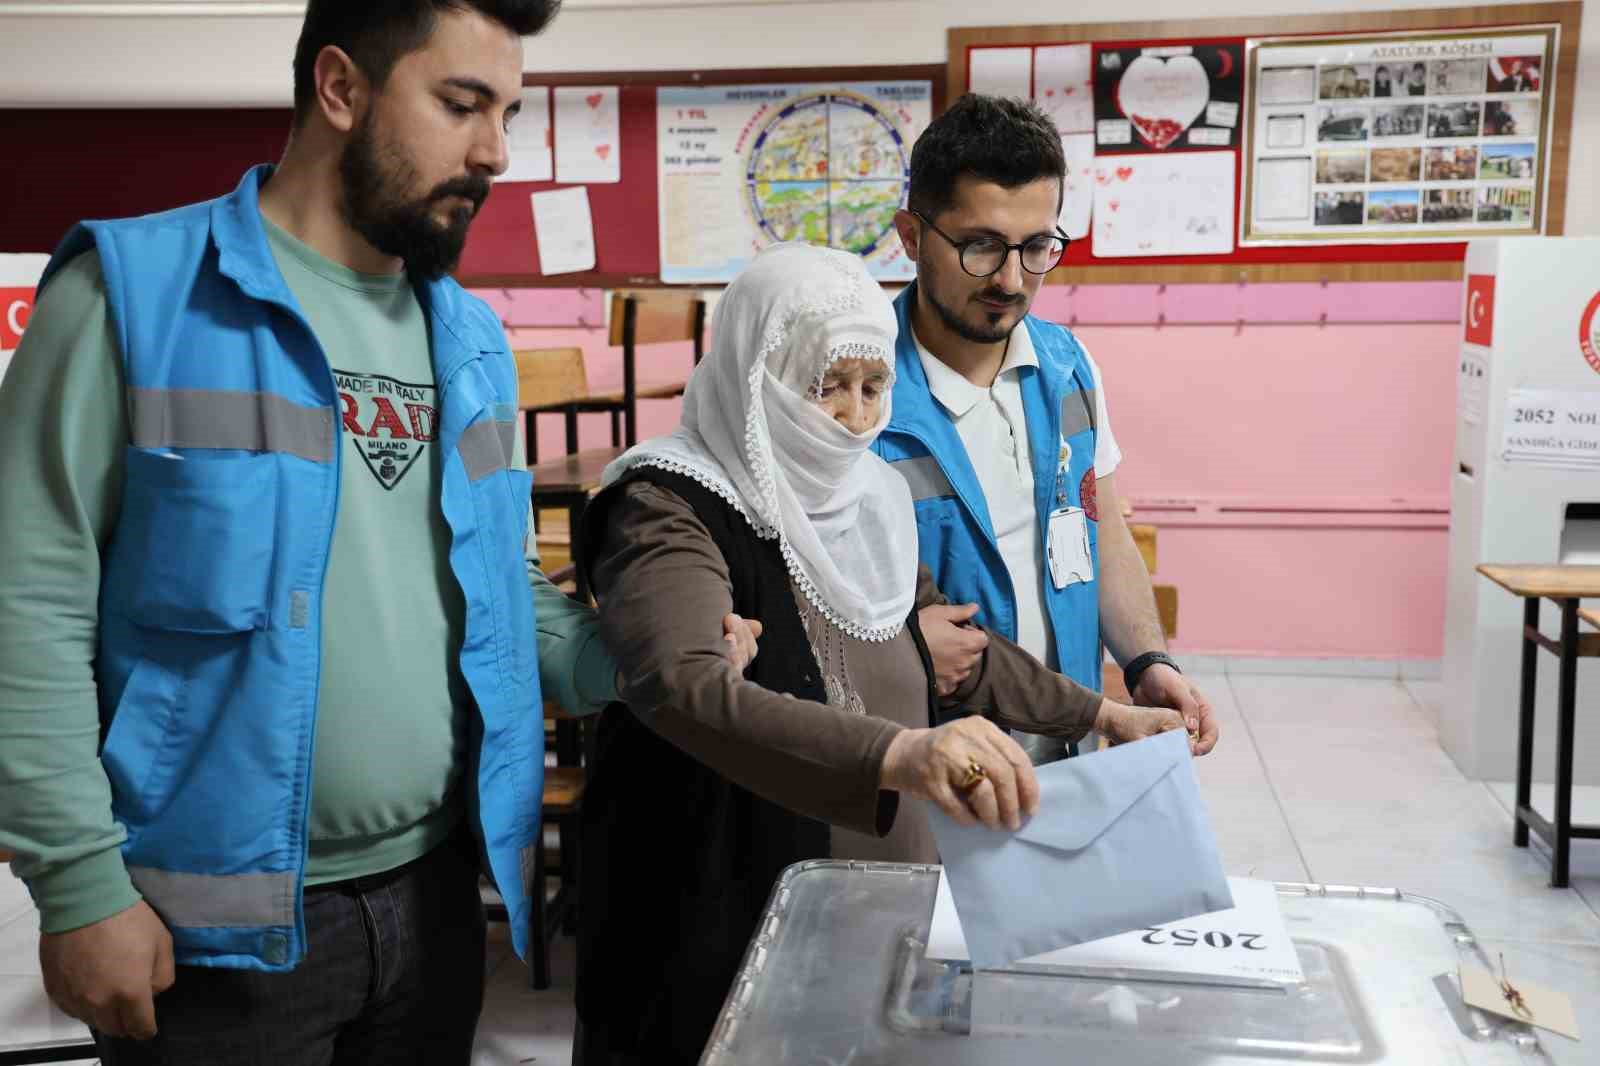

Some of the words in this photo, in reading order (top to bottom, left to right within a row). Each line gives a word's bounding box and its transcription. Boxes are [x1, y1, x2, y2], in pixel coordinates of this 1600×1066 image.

[335, 376, 373, 392] MADE
[378, 381, 393, 395] IN
[395, 385, 425, 400] ITALY
[339, 392, 437, 441] RAD
[1513, 407, 1555, 424] 2052
[1566, 410, 1600, 425] NOL
[368, 440, 408, 451] MILANO
[1141, 927, 1268, 951] 2052
